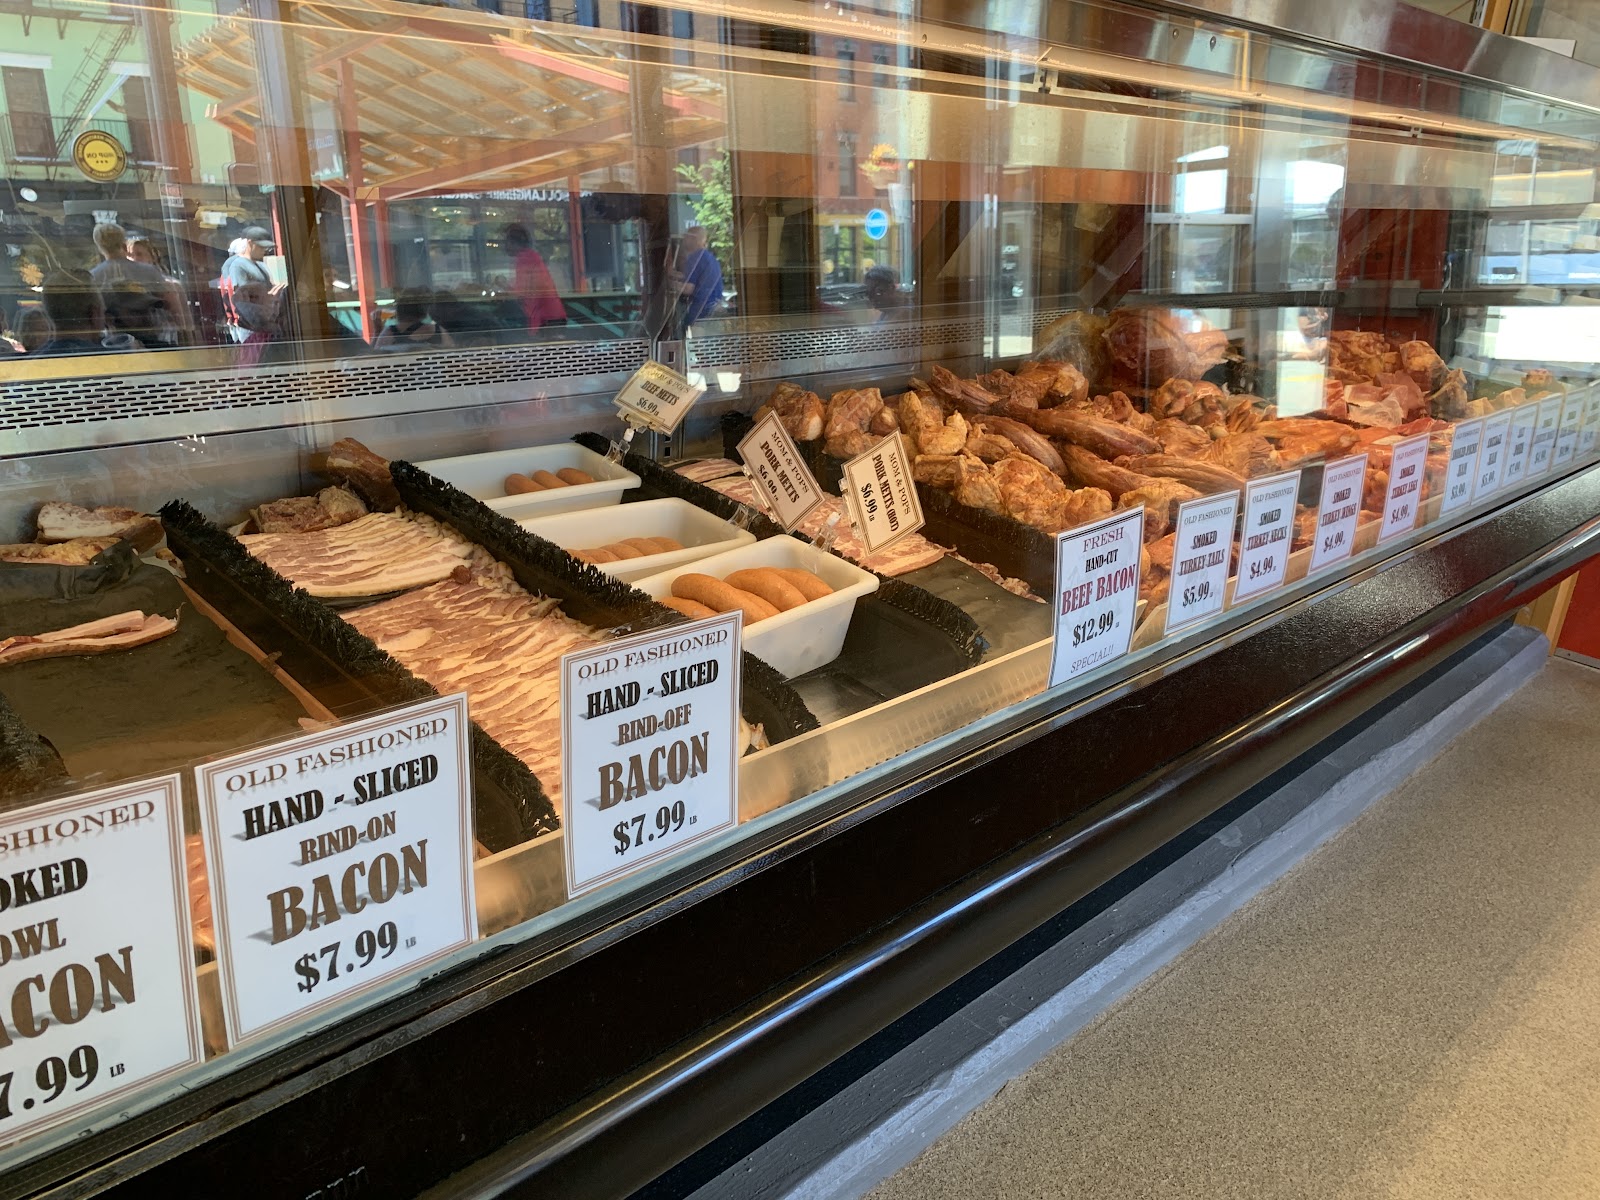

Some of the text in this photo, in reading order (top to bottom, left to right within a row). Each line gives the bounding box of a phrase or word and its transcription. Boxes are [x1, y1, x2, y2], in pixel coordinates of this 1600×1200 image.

[636, 397, 658, 413] $6.99
[641, 381, 680, 405] BEEF METTS
[760, 441, 800, 503] PORK METTS
[771, 431, 810, 493] MOM & POPS
[861, 483, 878, 514] $6.99
[872, 454, 900, 532] PORK METTS (HOT)
[889, 452, 911, 515] MOM & POPS
[1332, 487, 1352, 504] SMOKED
[1252, 494, 1264, 504] OLD
[1391, 504, 1409, 524] $4.99
[1184, 506, 1232, 526] OLD FASHIONED
[1259, 508, 1282, 526] SMOKED
[1321, 508, 1341, 527] TURKEY
[1082, 527, 1124, 553] FRESH
[1192, 530, 1218, 550] SMOKED
[1247, 525, 1288, 551] TURKEY NECKS
[1323, 531, 1344, 553] $4.99
[1085, 549, 1119, 574] HAND-CUT
[1179, 548, 1225, 577] TURKEY TAILS
[1250, 556, 1274, 580] $4.99
[1061, 564, 1136, 616] BEEF BACON
[1183, 581, 1210, 608] $5.99
[1072, 610, 1114, 648] $12.99
[578, 629, 728, 679] OLD FASHIONED
[1070, 644, 1114, 674] SPECIAL!!
[586, 681, 640, 720] HAND
[660, 659, 719, 697] SLICED
[618, 703, 692, 746] RIND-OFF
[225, 717, 448, 793] OLD FASHIONED
[598, 731, 709, 812] BACON
[243, 789, 324, 841] HAND
[353, 754, 439, 805] SLICED
[299, 810, 397, 865] RIND-ON
[613, 800, 698, 856] $7.99 LB
[266, 839, 428, 946] BACON
[294, 921, 417, 994] $7.99 LB
[109, 1062, 126, 1078] LB
